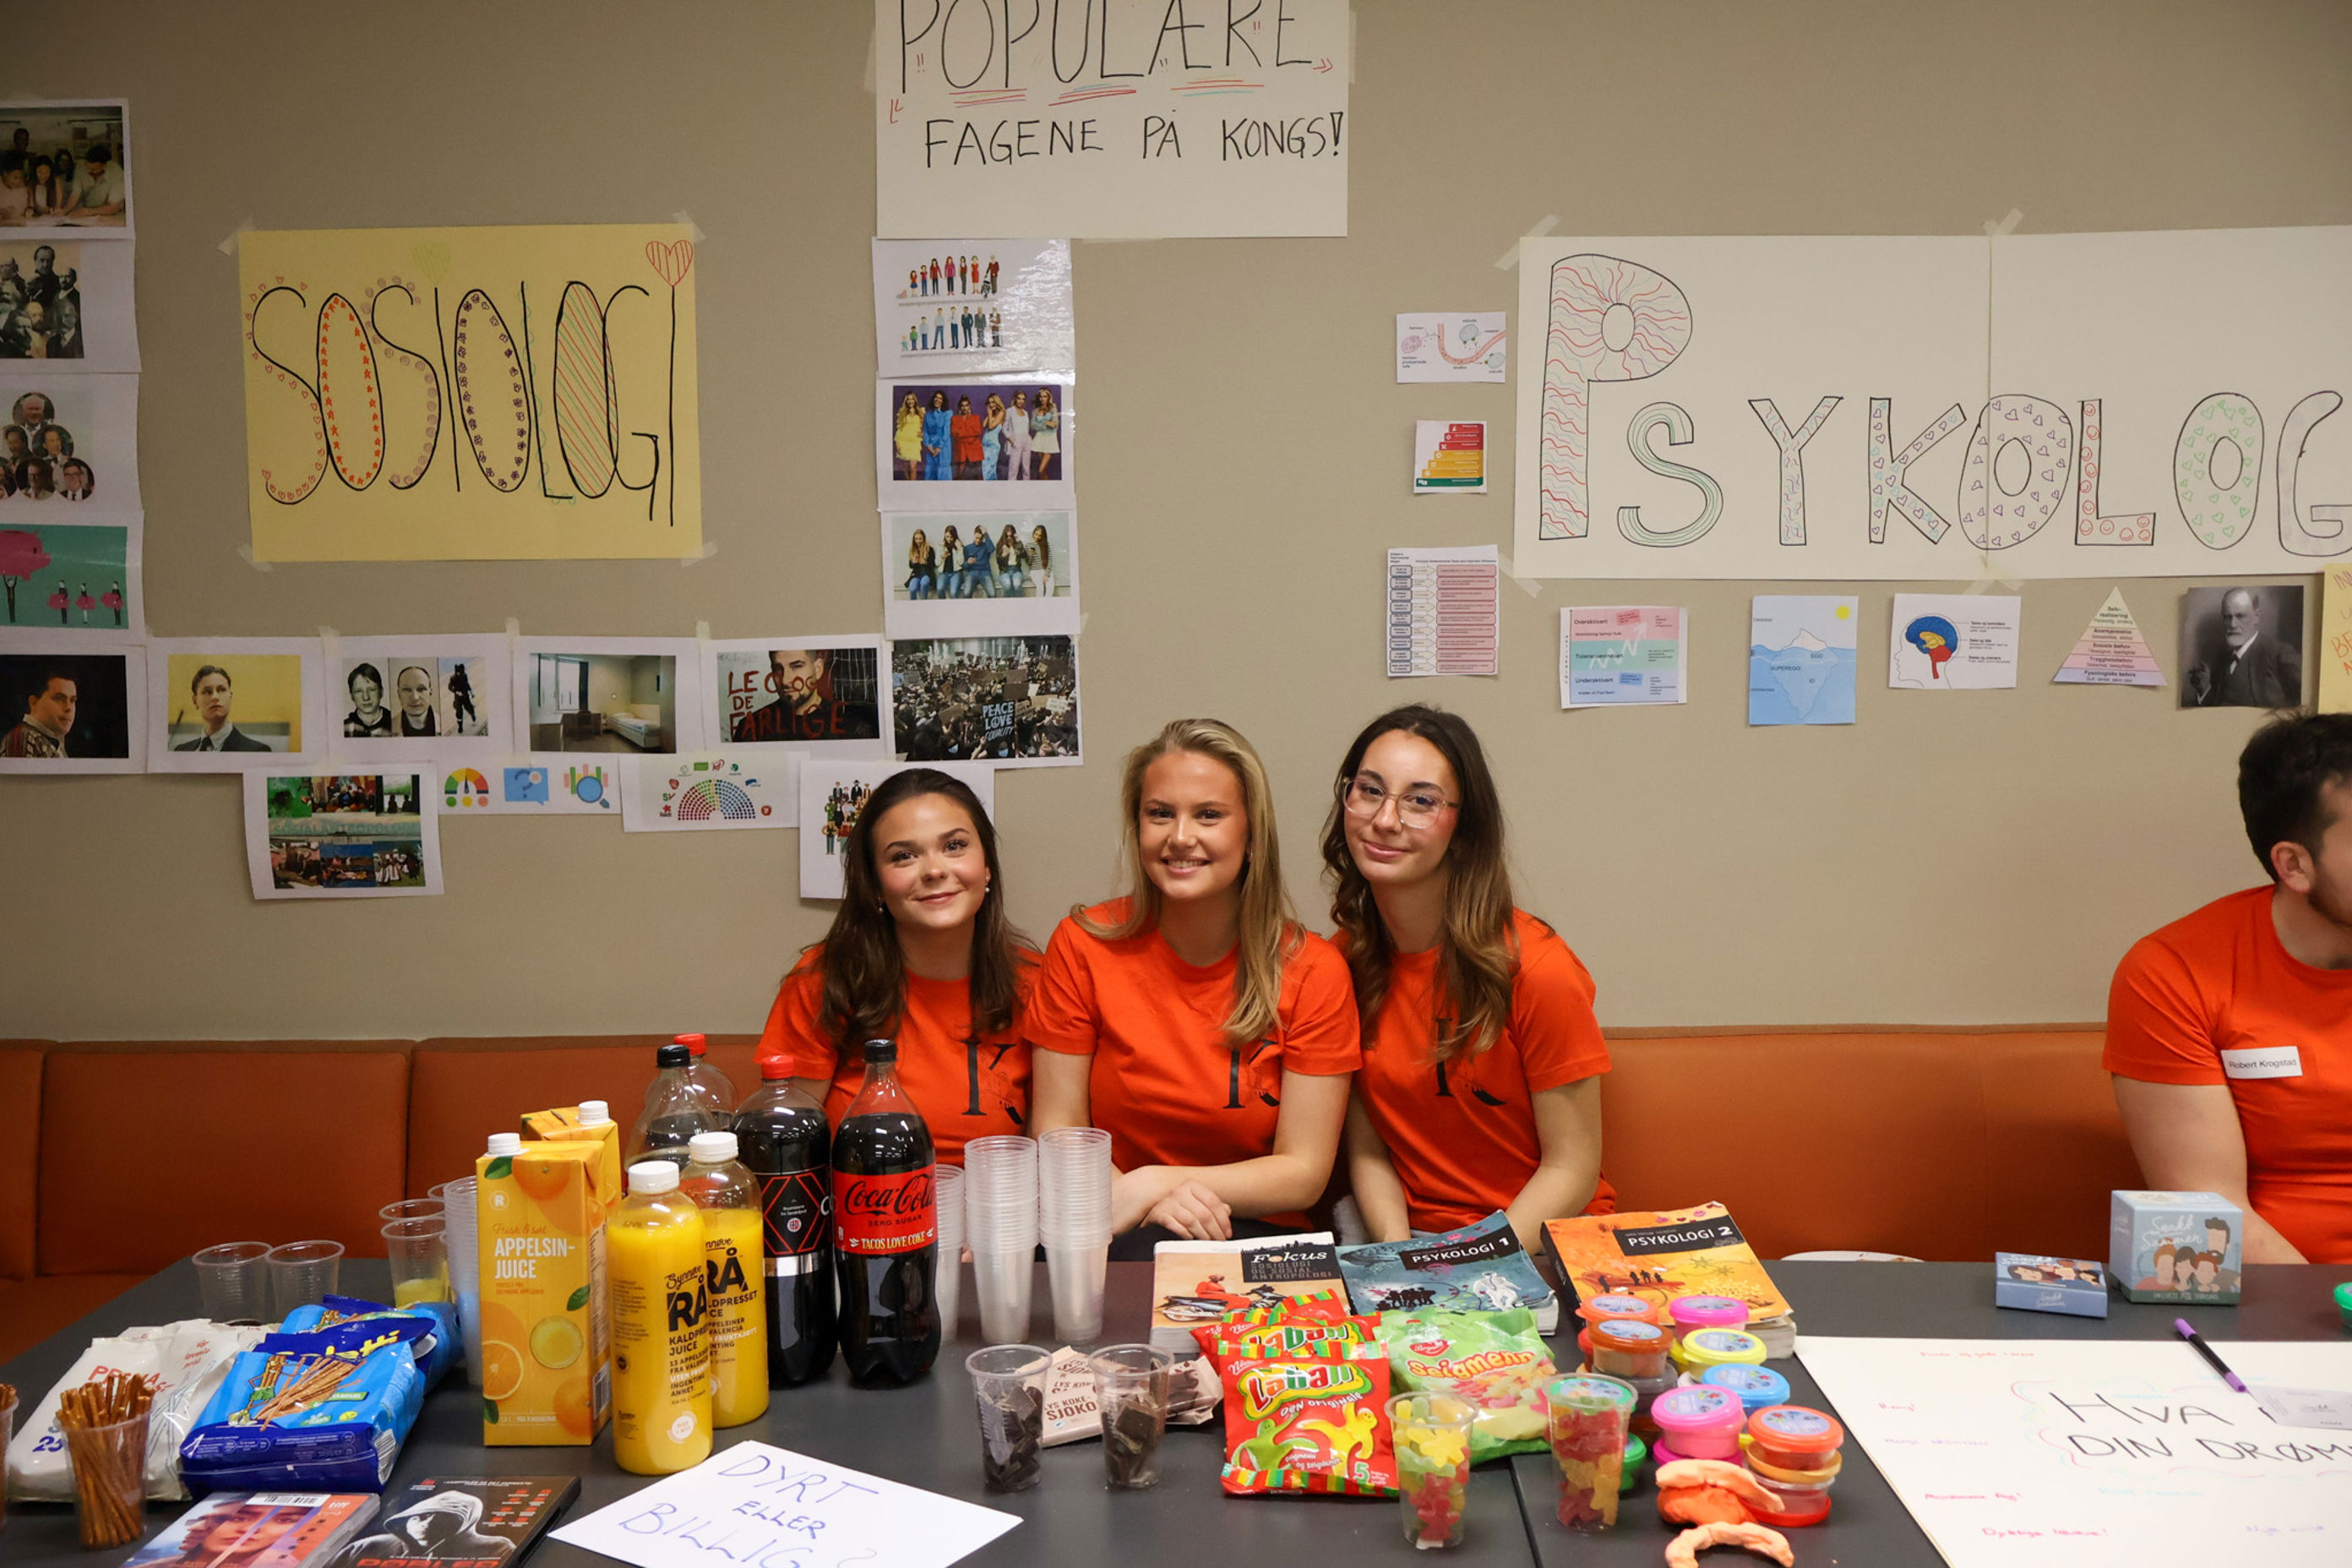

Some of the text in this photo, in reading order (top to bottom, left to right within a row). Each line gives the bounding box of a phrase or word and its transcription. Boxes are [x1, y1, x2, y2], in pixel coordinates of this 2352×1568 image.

[901, 0, 1313, 94] POPULÆRE
[925, 118, 1103, 168] FAGENE
[1222, 111, 1344, 161] KONGS!
[732, 695, 754, 711] DE
[983, 701, 1015, 718] PEACE
[730, 700, 849, 743] FARLIGE
[984, 714, 1013, 731] LOVE
[2230, 1059, 2297, 1070] Robert Krogstad
[845, 1173, 935, 1217] Coca-Cola
[868, 1214, 923, 1228] ZERO SUGAR
[493, 1237, 576, 1258] APPELSIN-
[860, 1229, 927, 1250] TACOS LOVE COKE
[1627, 1228, 1716, 1249] PSYKOLOGI
[1718, 1226, 1734, 1237] 2
[1412, 1242, 1495, 1264] PSYKOLOGI
[1499, 1237, 1510, 1247] 1
[494, 1259, 538, 1280] JUICE
[1252, 1271, 1333, 1280] ANTROPOLOGI
[669, 1339, 699, 1357] JUICE
[1407, 1351, 1536, 1380] Seigmenn
[1247, 1363, 1354, 1413] Laban
[1046, 1401, 1097, 1421] SJOKO
[2049, 1391, 2235, 1426] HVA
[2067, 1434, 2174, 1460] DIN
[716, 1454, 880, 1504] DYRT
[1353, 1462, 1369, 1484] 5
[731, 1500, 827, 1540] ELLER
